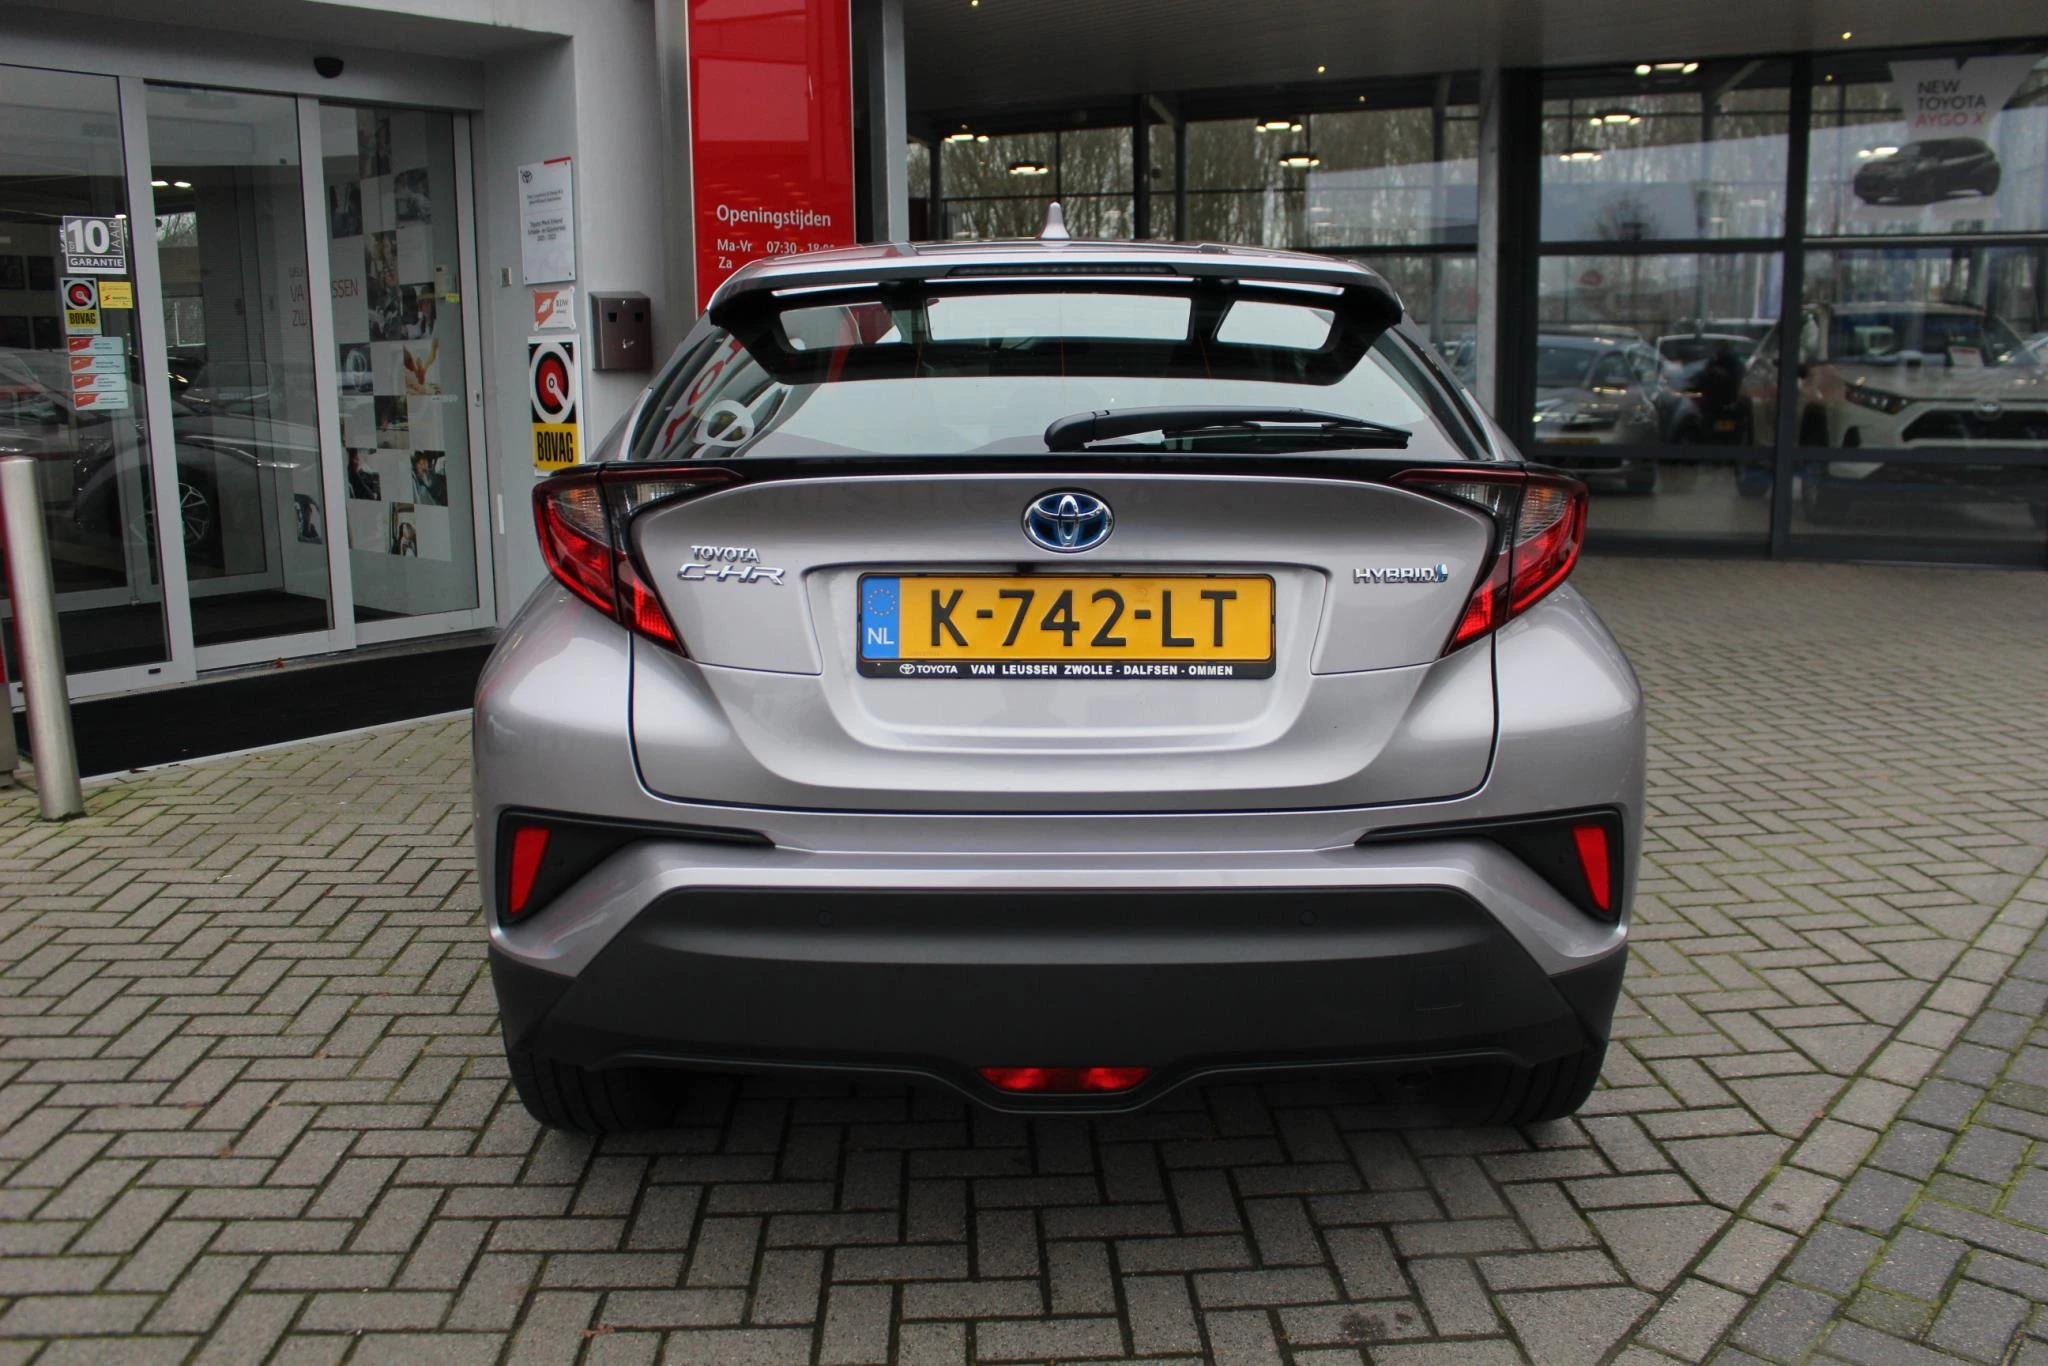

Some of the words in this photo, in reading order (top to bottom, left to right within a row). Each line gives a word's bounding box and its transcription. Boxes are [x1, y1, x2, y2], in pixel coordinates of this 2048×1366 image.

[1918, 80, 1960, 93] NEW
[1918, 94, 1987, 111] TOYOTA
[1916, 112, 1968, 128] AYGO
[716, 204, 831, 230] Openingstijden
[67, 219, 110, 254] 10
[108, 220, 122, 254] JAAR
[717, 239, 752, 252] Ma-Vr
[766, 241, 797, 254] 07:30
[70, 257, 123, 267] GARANTIE
[718, 256, 733, 269] Za
[68, 312, 96, 325] BOVAG
[536, 430, 574, 463] BOVAG
[691, 545, 760, 563] TOYOTA
[678, 563, 785, 585] C-HR
[1353, 567, 1435, 584] HYBRID
[931, 588, 1237, 647] K-742-LT
[867, 627, 895, 645] NL
[917, 664, 958, 675] TOYOTA
[970, 664, 996, 675] VAN
[1002, 664, 1058, 675] LEUSSEN
[1064, 664, 1113, 675] ZWOLLE
[1123, 664, 1178, 675] DALFSEN
[1188, 664, 1233, 675] OMMEN
